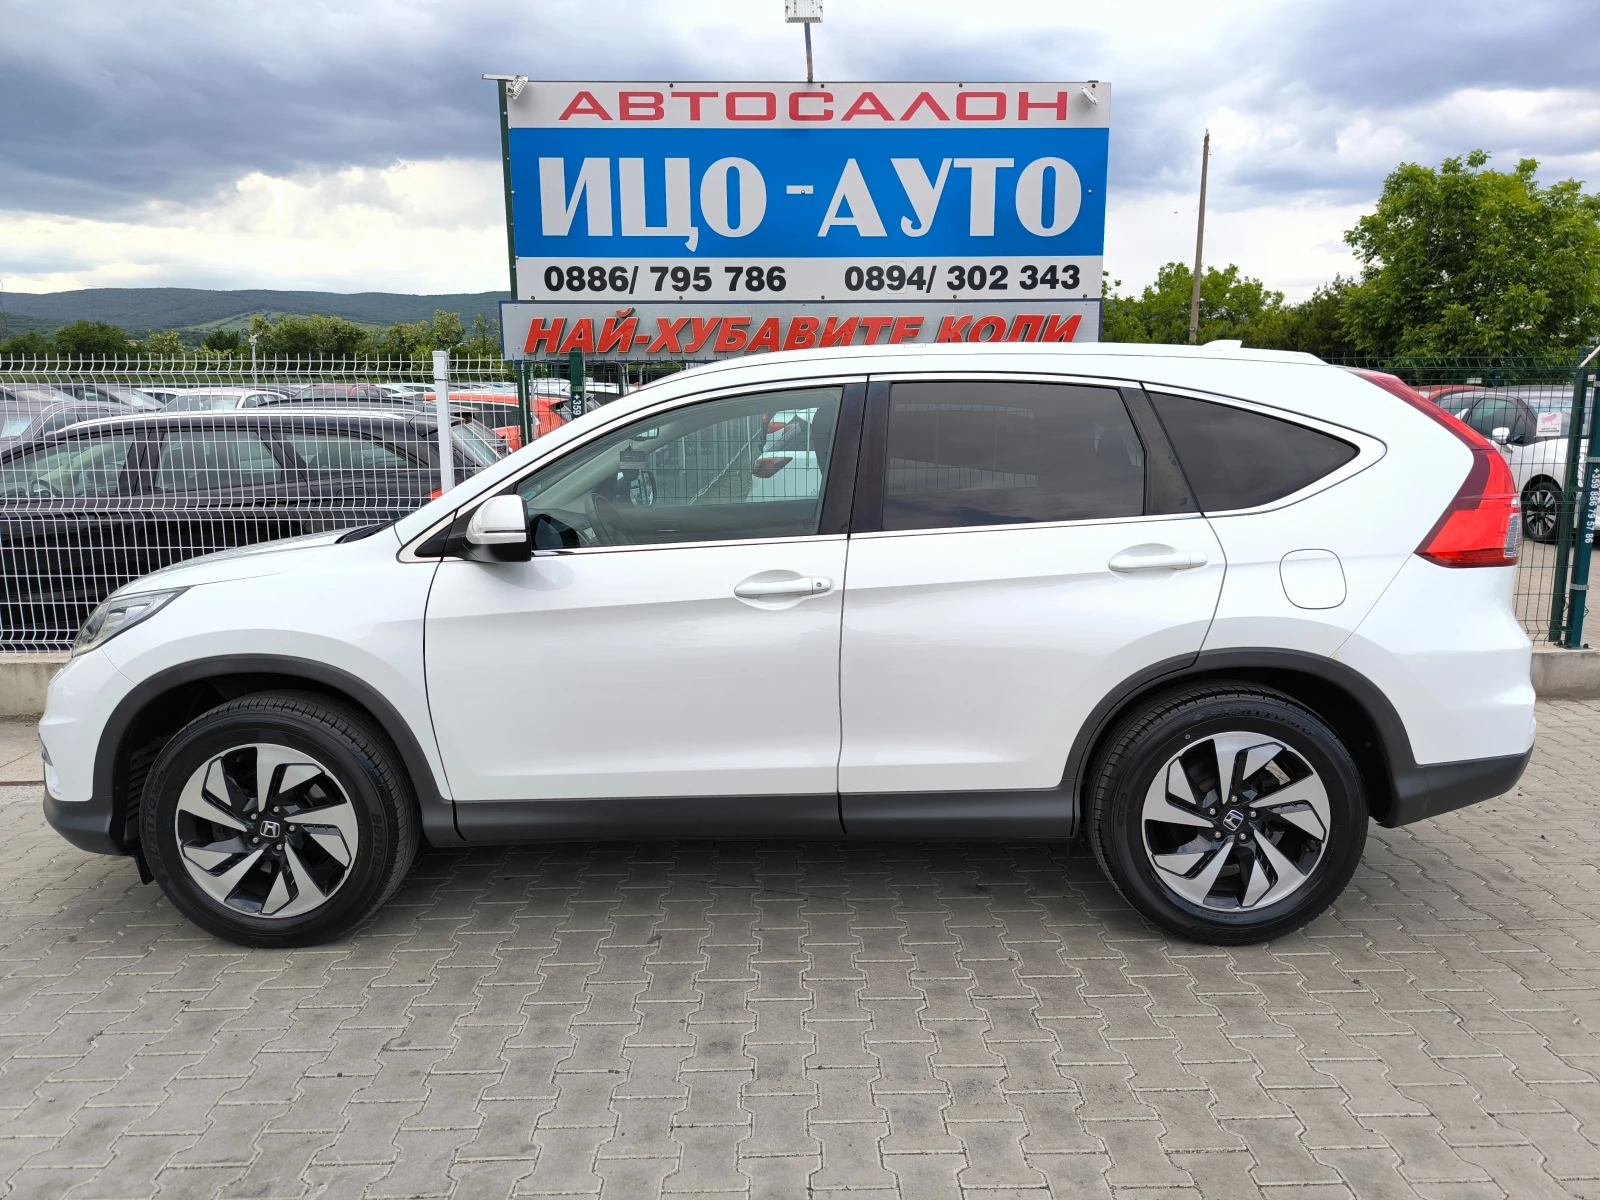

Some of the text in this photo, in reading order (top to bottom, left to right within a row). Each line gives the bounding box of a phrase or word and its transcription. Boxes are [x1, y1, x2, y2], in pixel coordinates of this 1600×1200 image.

[557, 91, 1068, 122] АВТОСАЛОН
[538, 156, 767, 253] ИЦО
[649, 266, 712, 292] 795
[724, 266, 787, 292] 786
[946, 265, 1009, 291] 302
[1019, 264, 1081, 290] 343
[523, 307, 1083, 354] НАЙ-ХУБАВИТЕ КОЛИ
[572, 393, 582, 415] +359
[1584, 467, 1600, 544] +359 886 79 57 86
